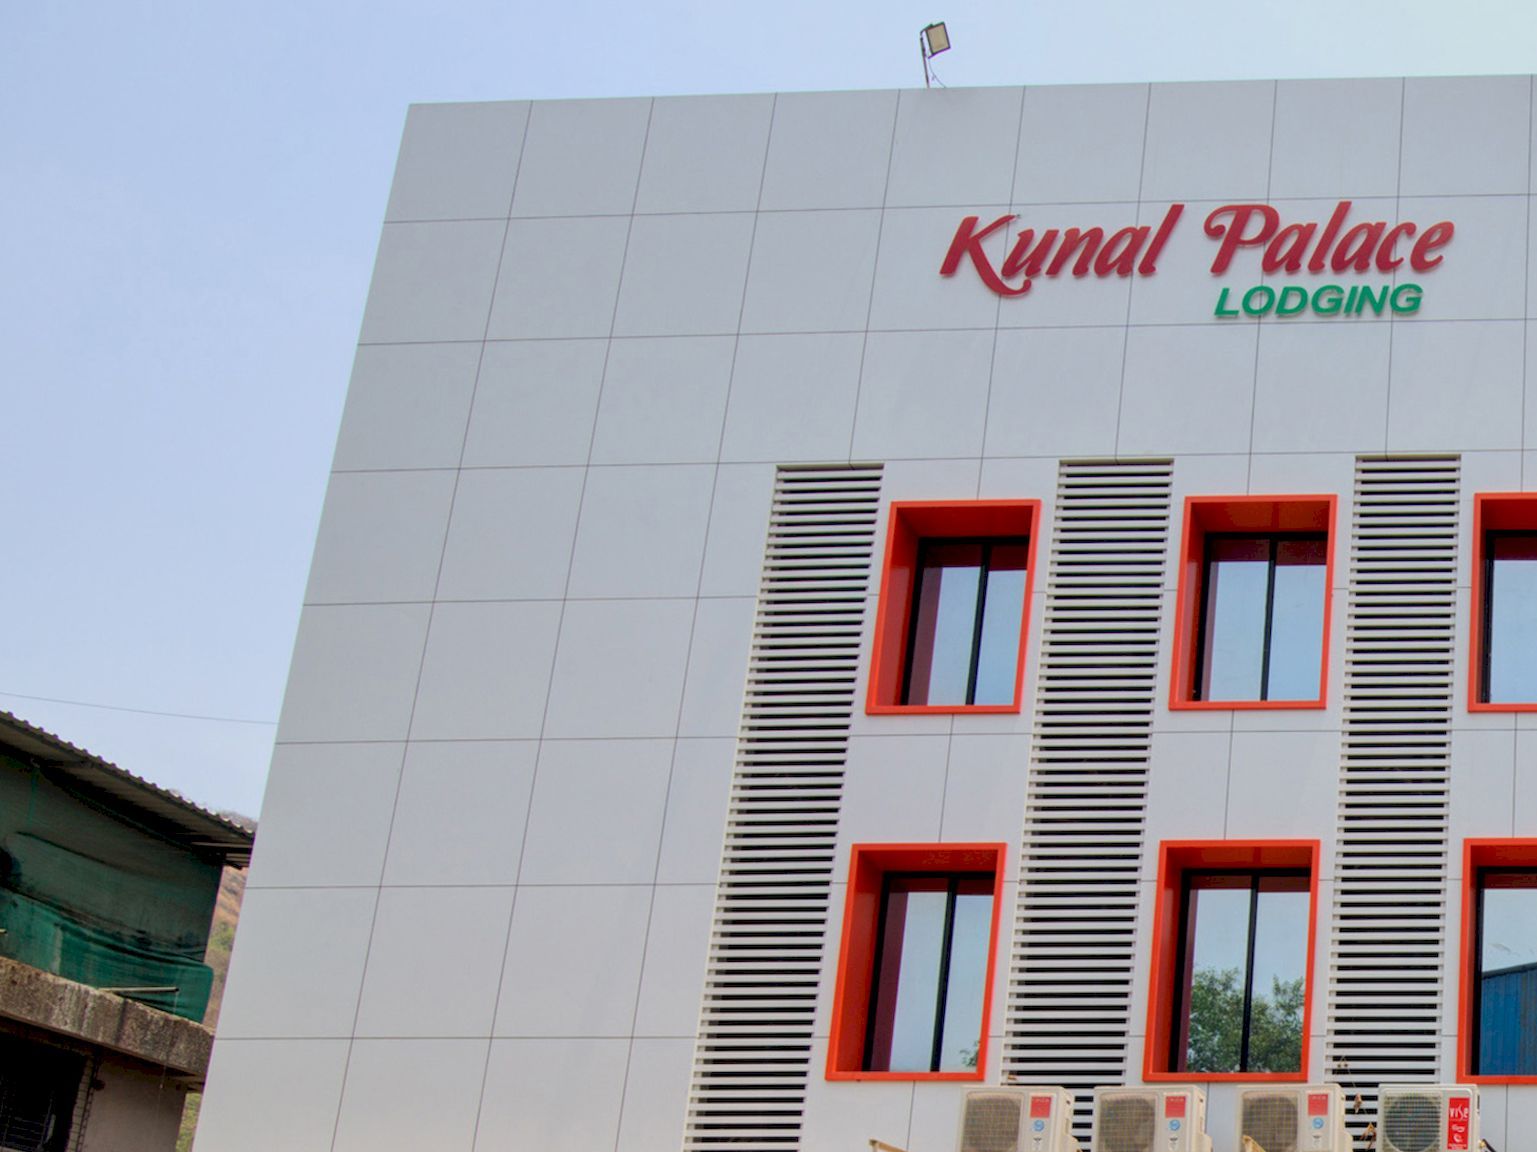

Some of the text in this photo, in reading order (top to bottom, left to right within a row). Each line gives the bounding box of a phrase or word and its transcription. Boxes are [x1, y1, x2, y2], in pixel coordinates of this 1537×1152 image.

[940, 201, 1454, 296] Kunal Palace
[1214, 284, 1423, 317] LODGING
